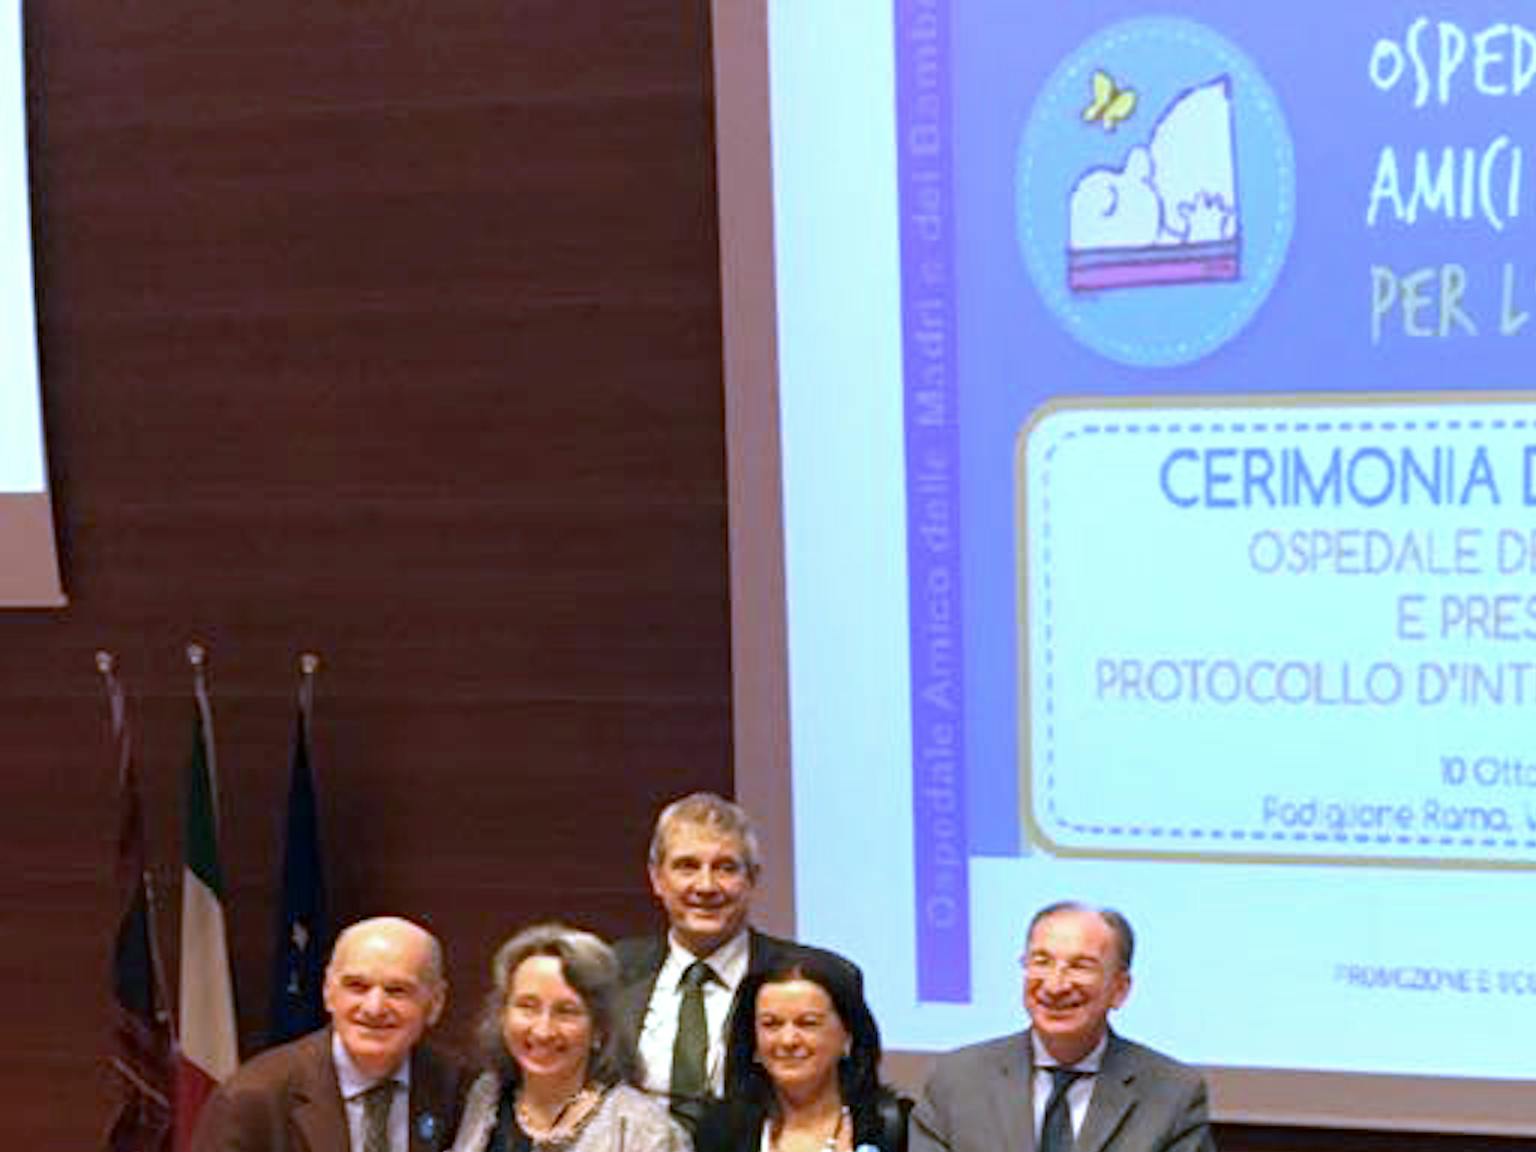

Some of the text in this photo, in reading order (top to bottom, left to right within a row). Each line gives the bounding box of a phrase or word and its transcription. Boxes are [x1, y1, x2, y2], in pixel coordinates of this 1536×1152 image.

[1367, 136, 1522, 230] AMICI
[1370, 262, 1477, 346] PER
[1158, 444, 1503, 508] CERIMONIA
[1247, 526, 1484, 576] OSPEDALE
[1397, 594, 1427, 641] E
[1095, 657, 1404, 706] PROTOCOLLO
